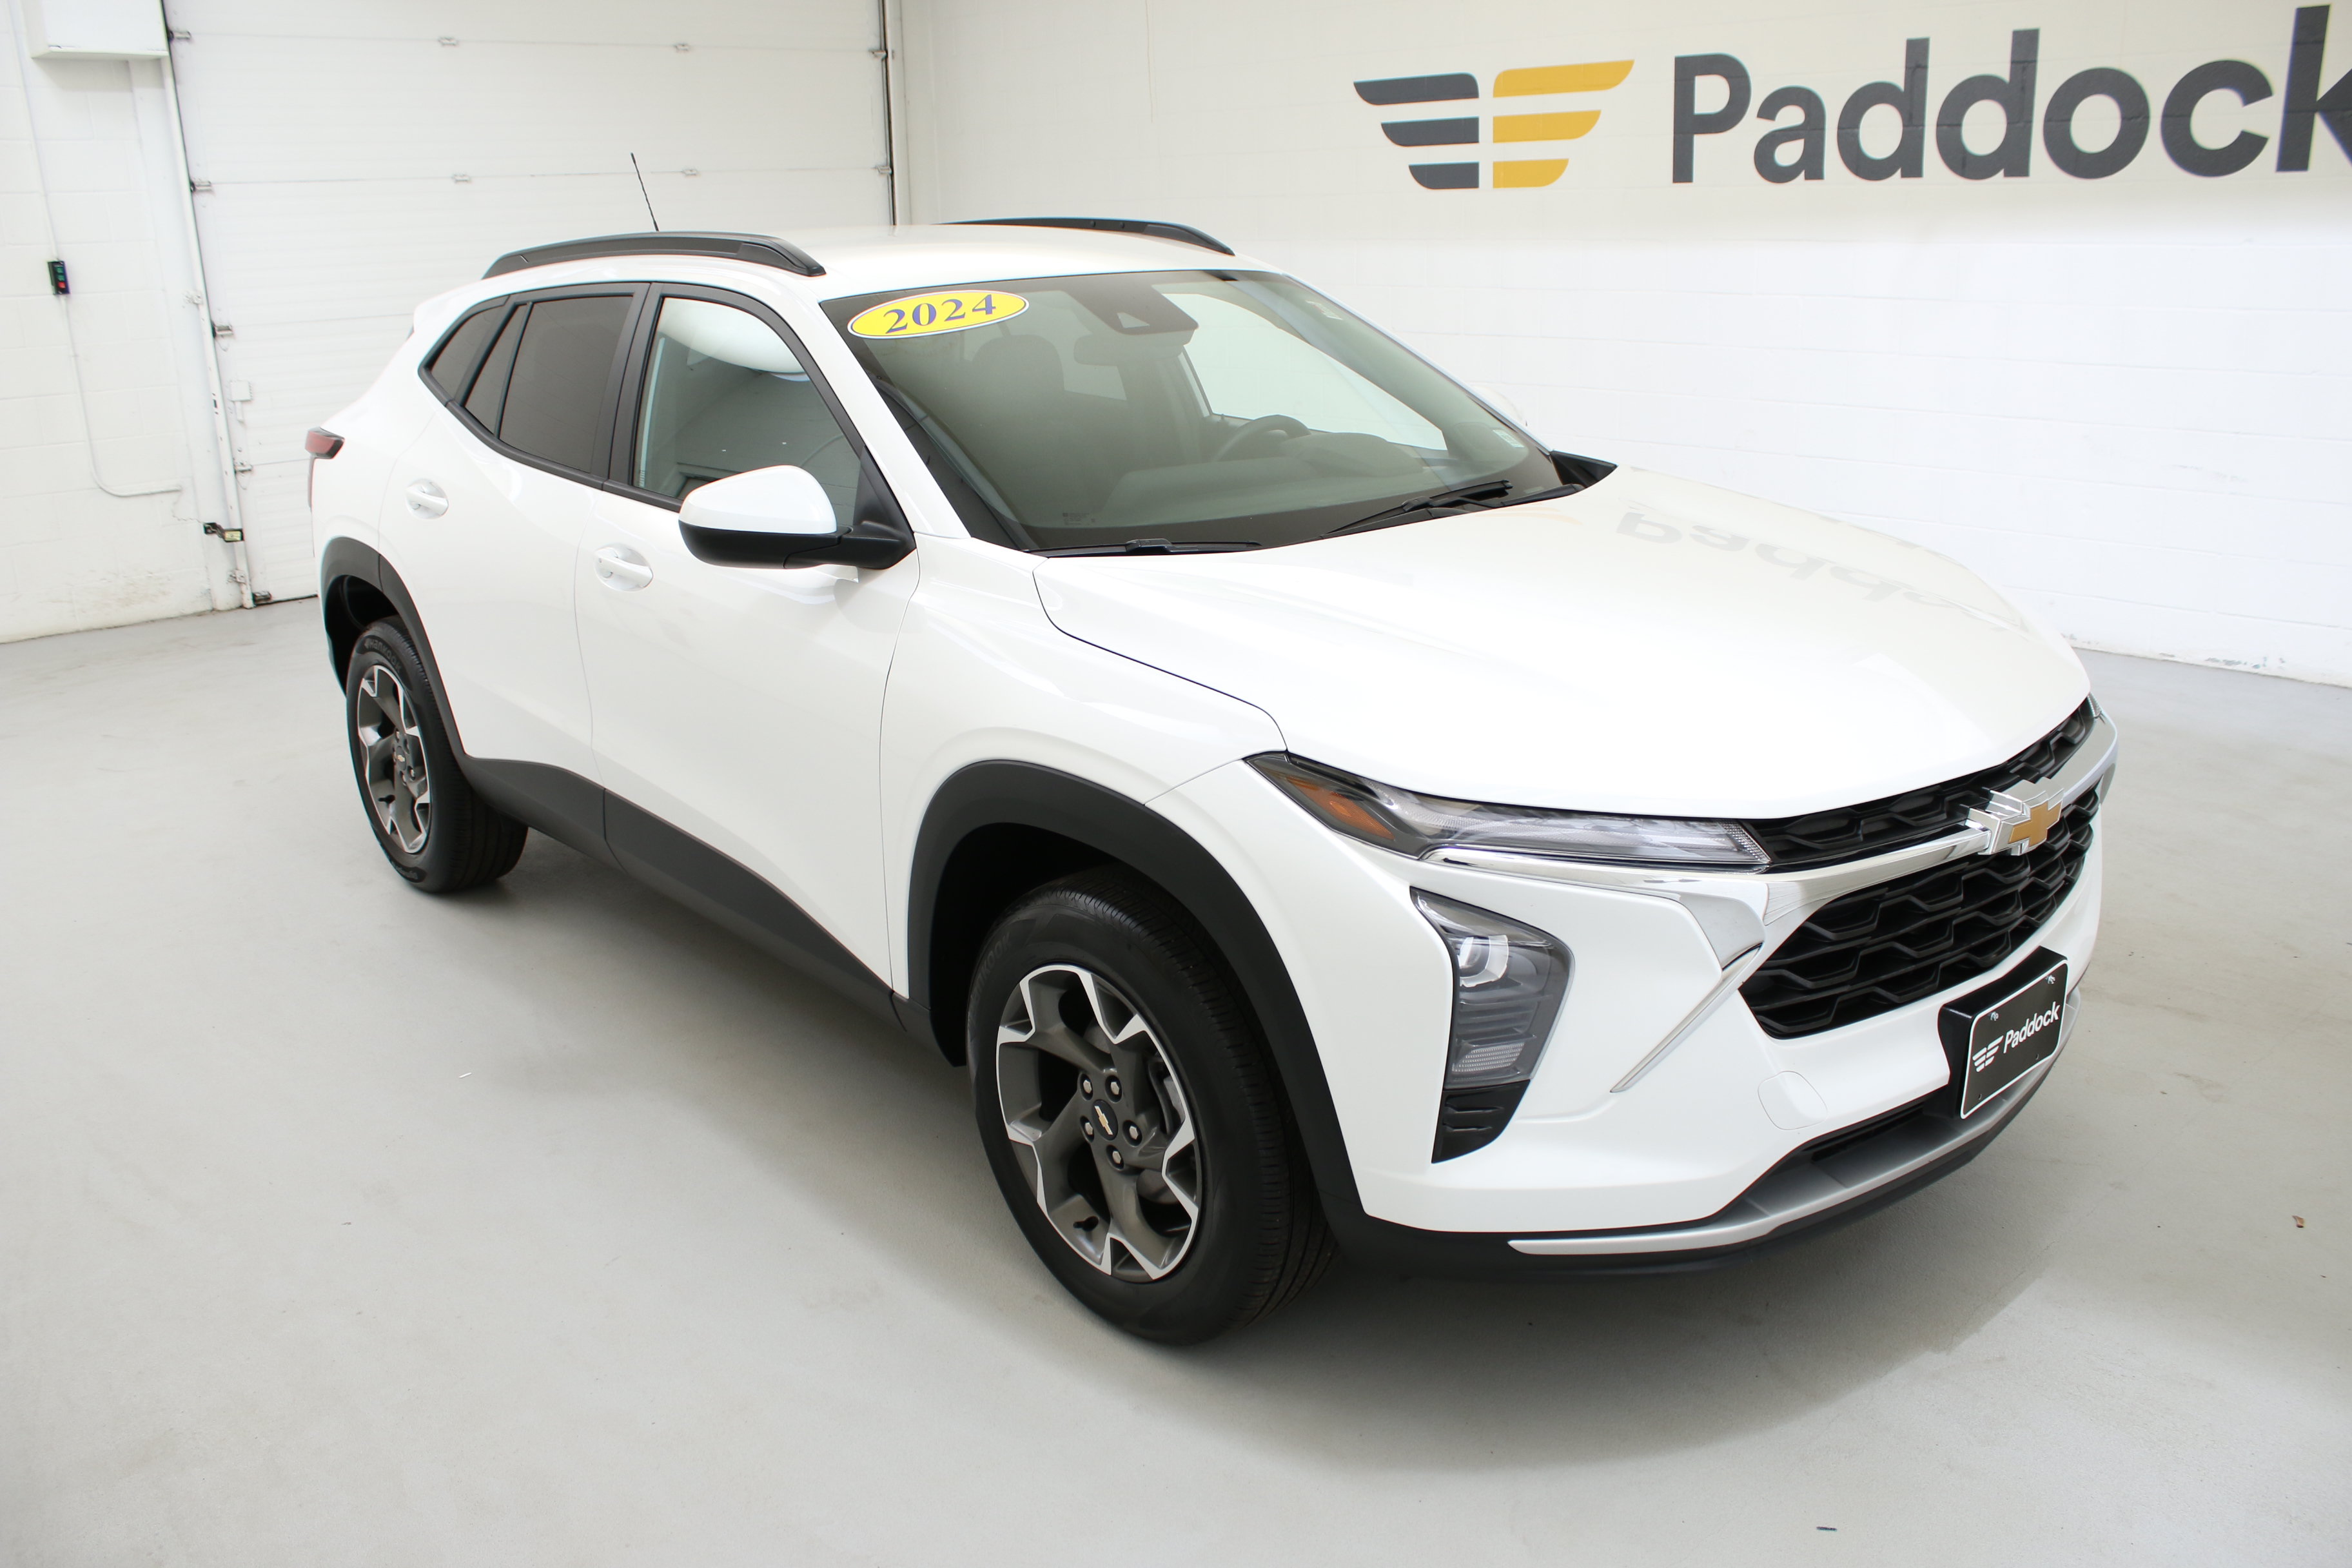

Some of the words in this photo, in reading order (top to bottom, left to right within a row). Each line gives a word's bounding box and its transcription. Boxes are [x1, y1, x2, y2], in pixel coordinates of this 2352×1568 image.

[1671, 4, 2352, 184] Paddock
[883, 294, 997, 335] 2024
[2003, 1001, 2061, 1054] Paddock
